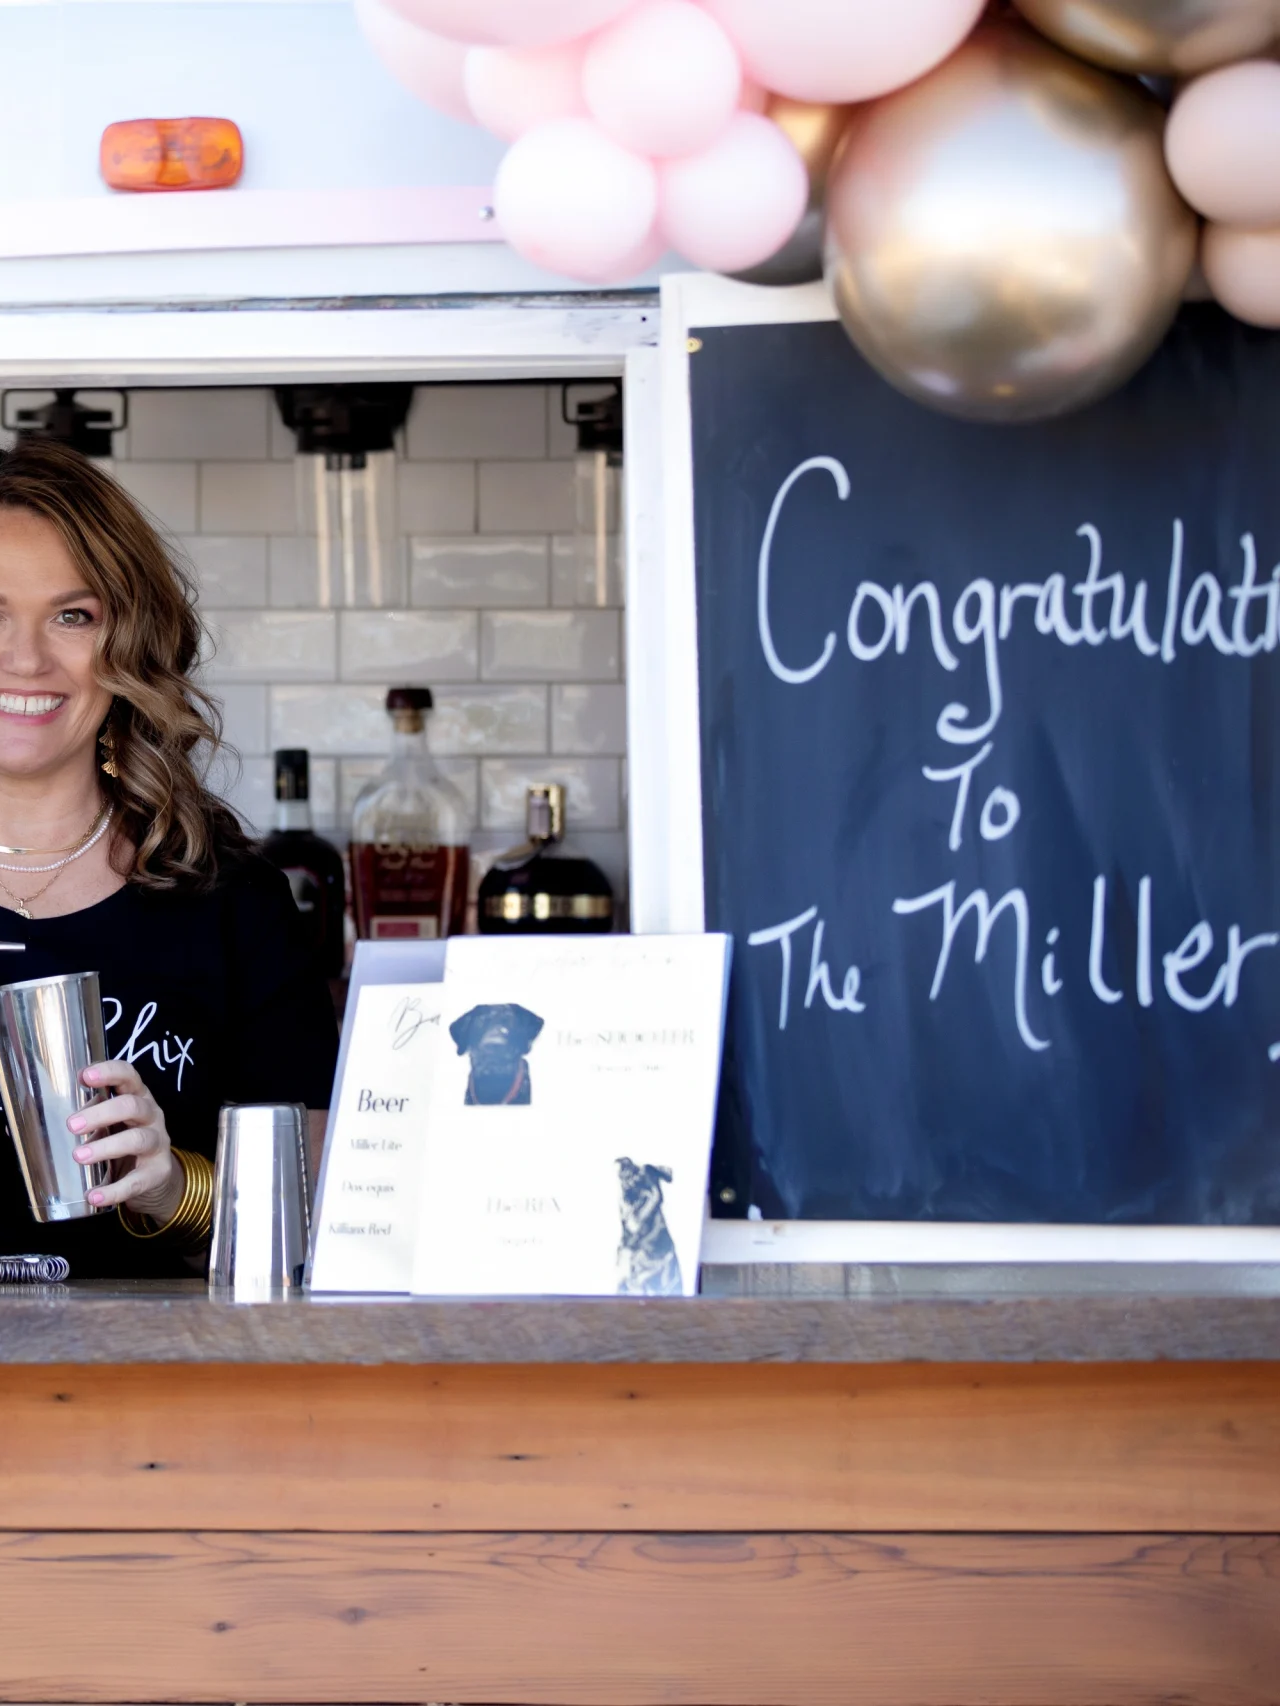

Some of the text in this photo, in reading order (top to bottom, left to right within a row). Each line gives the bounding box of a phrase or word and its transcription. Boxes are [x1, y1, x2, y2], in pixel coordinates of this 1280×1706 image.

[758, 456, 1280, 745] Congratulati
[923, 744, 1020, 851] To
[748, 875, 1280, 1060] The Miller
[357, 1089, 410, 1113] Beer
[368, 1222, 392, 1236] Red
